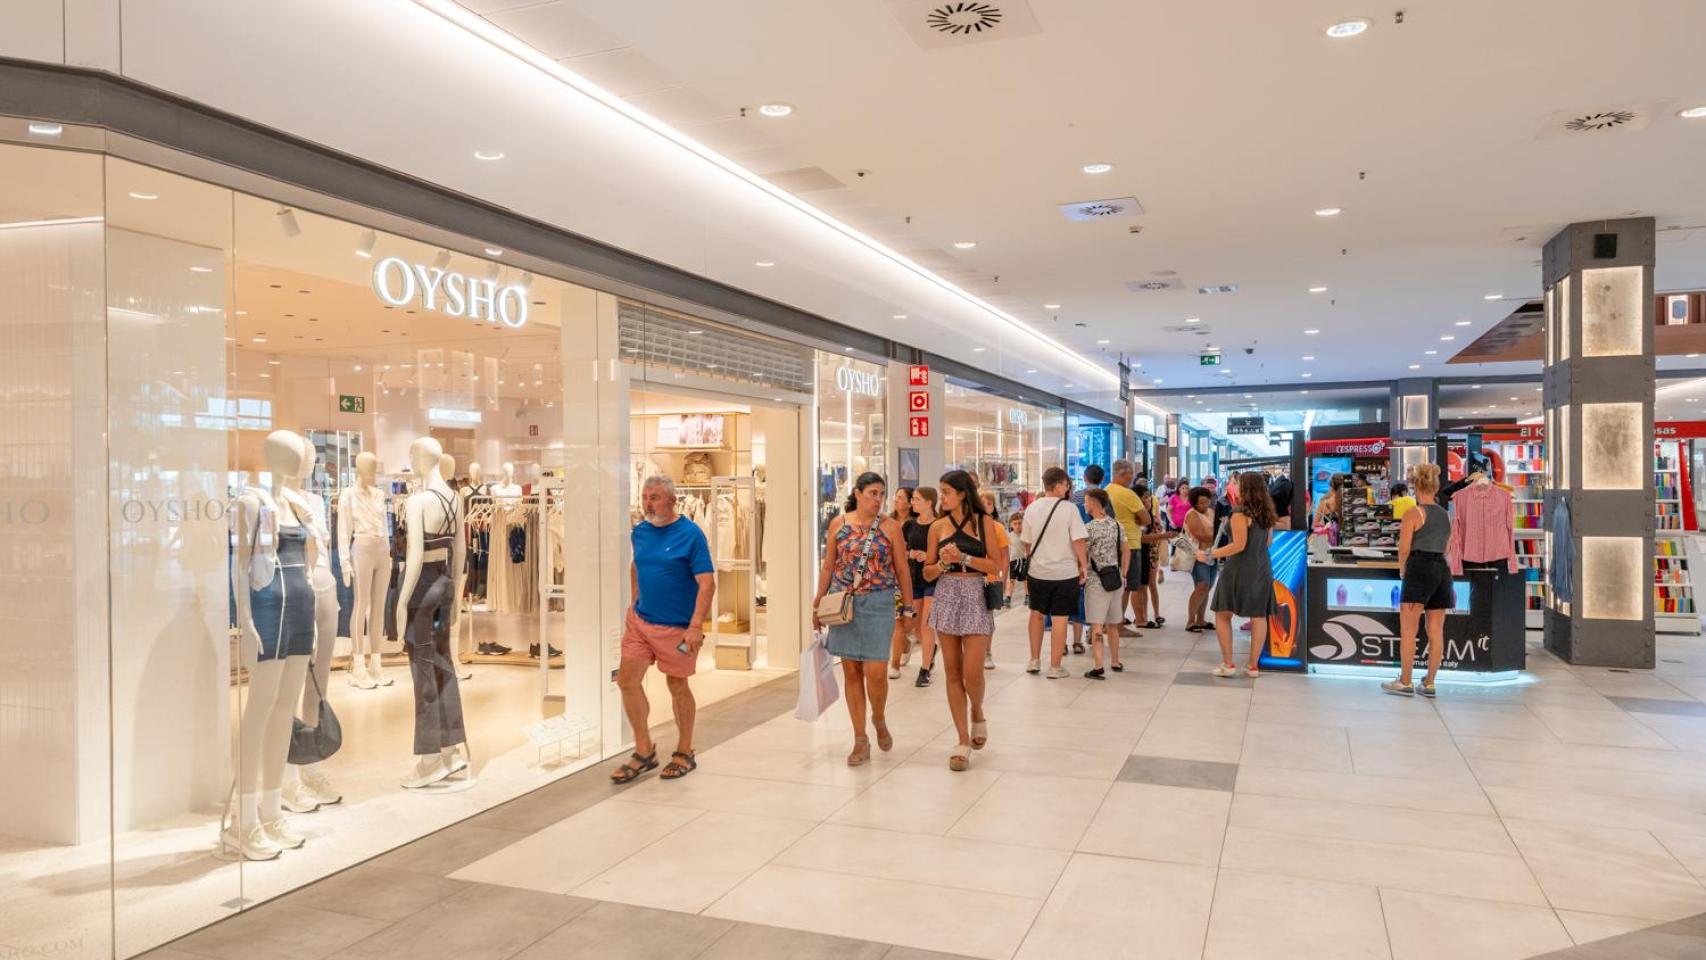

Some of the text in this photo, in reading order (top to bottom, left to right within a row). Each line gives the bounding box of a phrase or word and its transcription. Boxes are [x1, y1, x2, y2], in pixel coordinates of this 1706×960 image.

[374, 257, 528, 328] OYSHO
[837, 367, 879, 397] OYSHO
[1520, 427, 1531, 437] El
[122, 499, 224, 523] OYSHO
[1361, 636, 1475, 661] STAM
